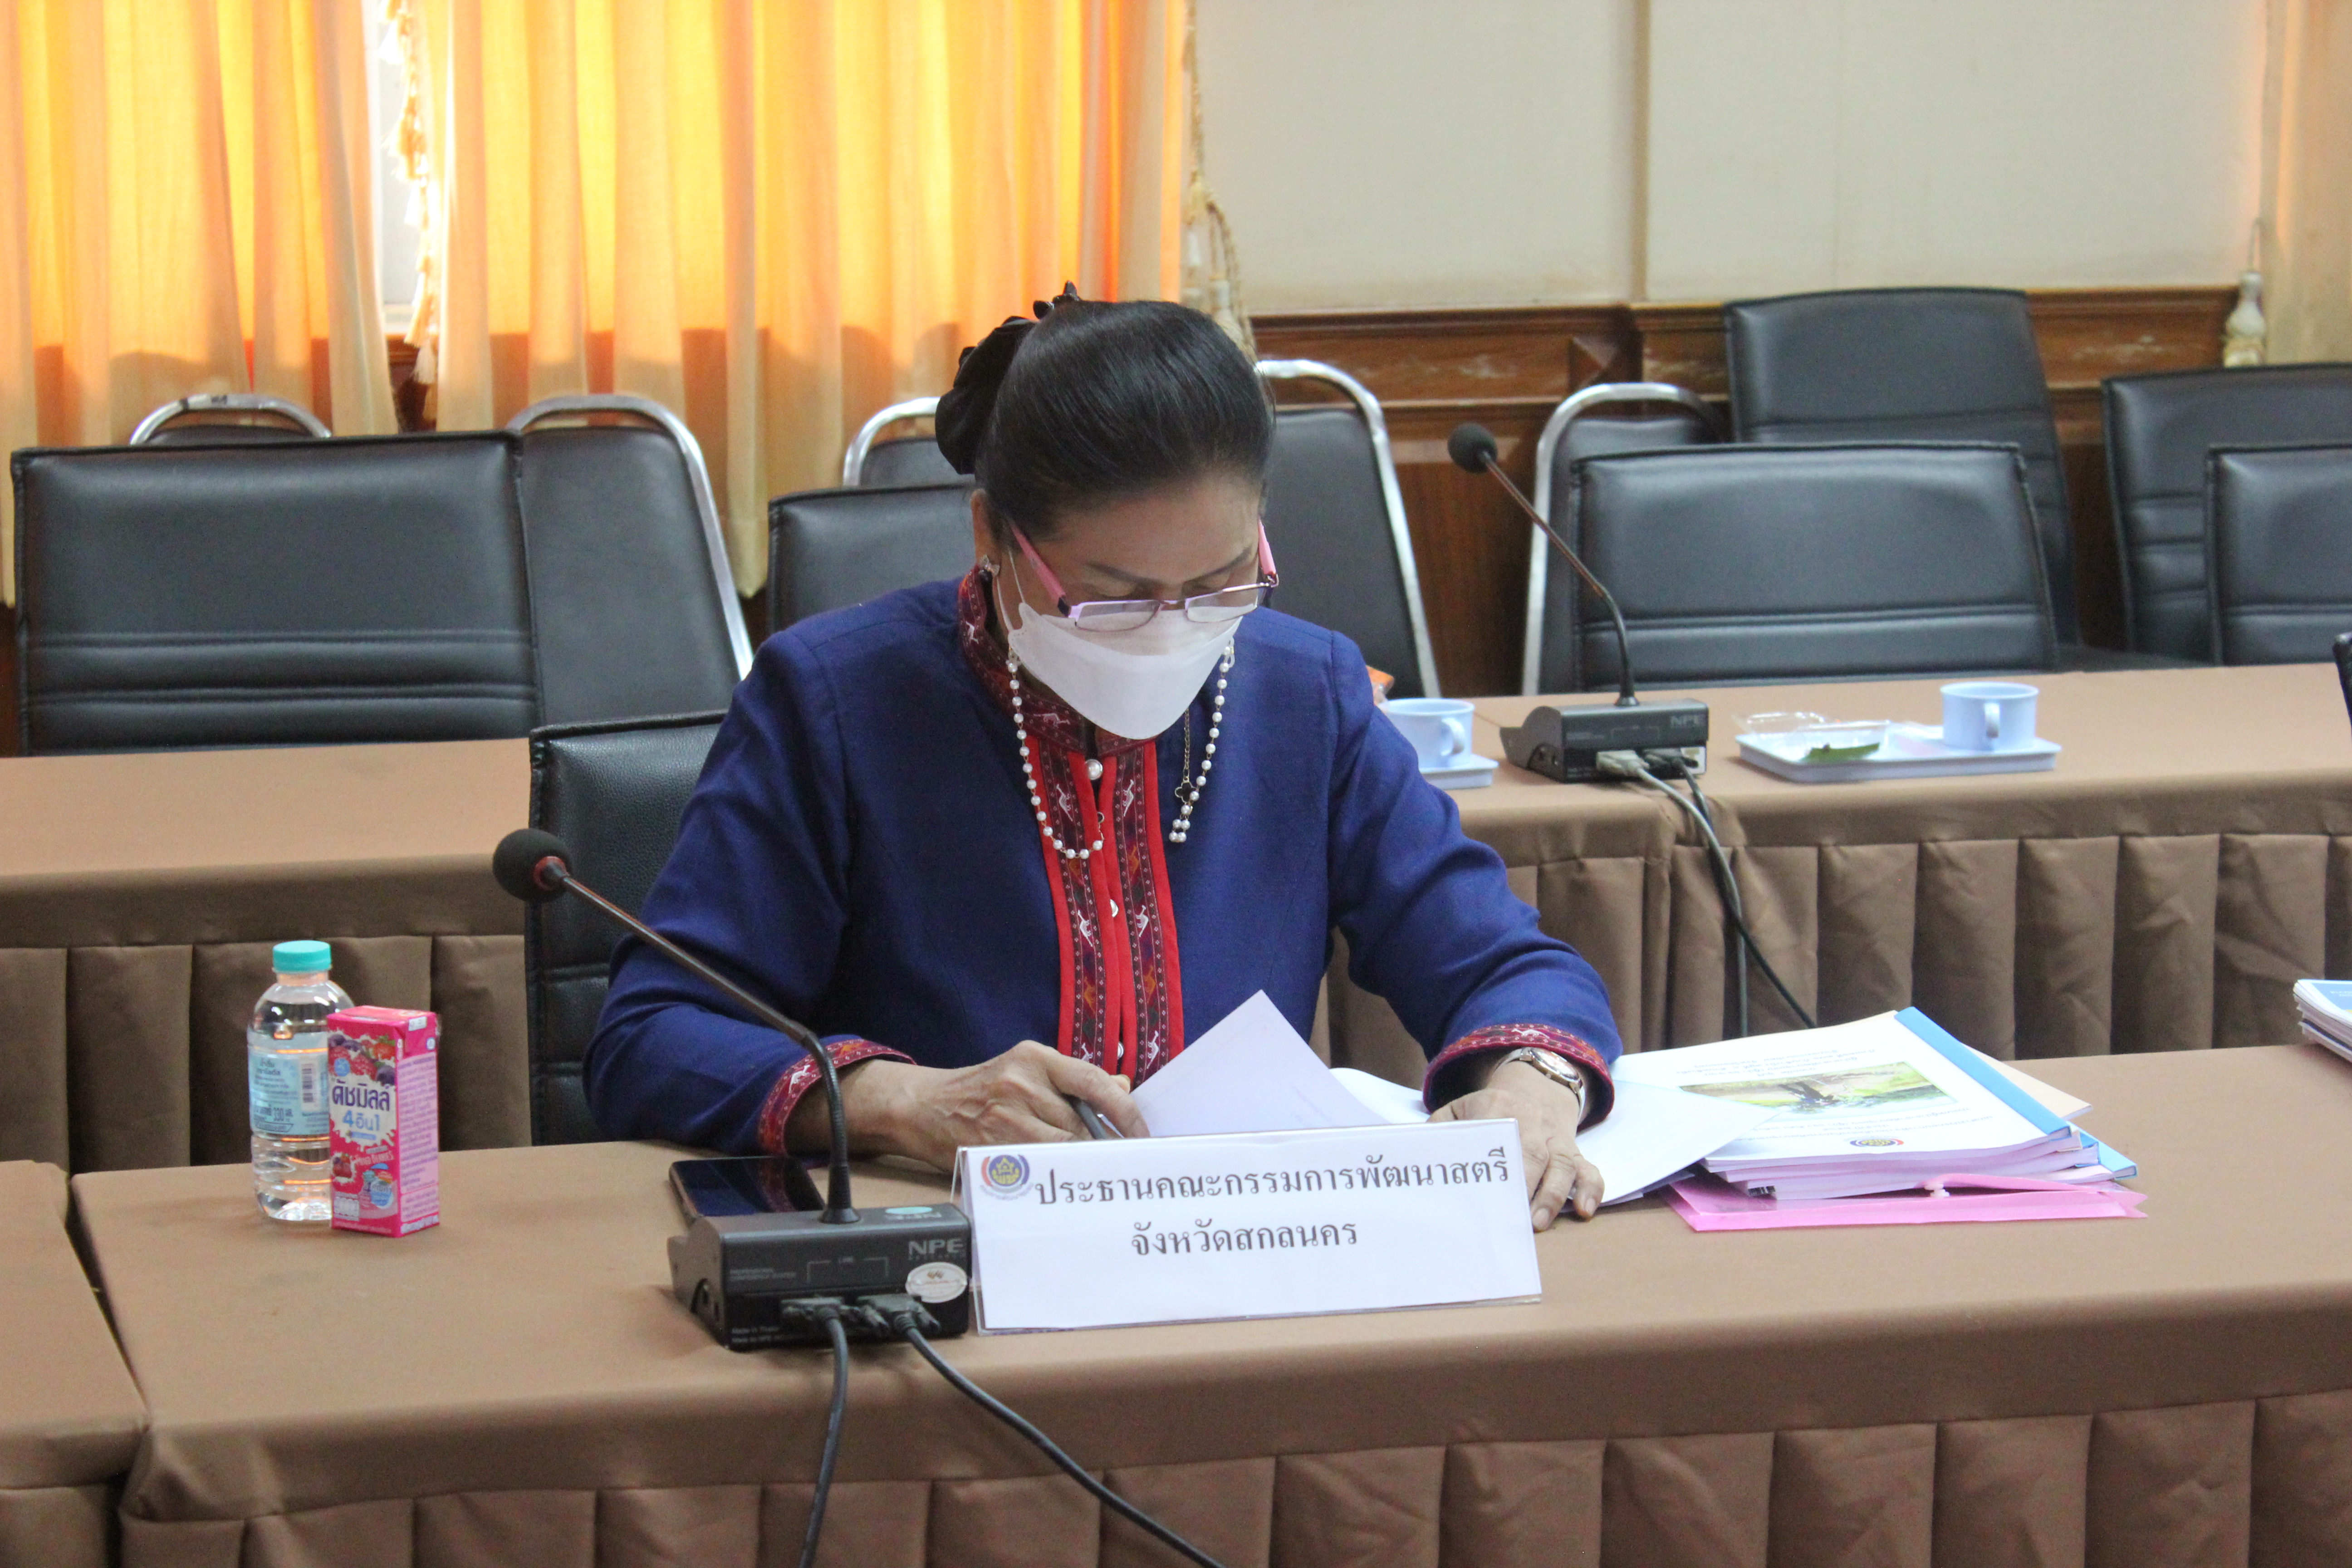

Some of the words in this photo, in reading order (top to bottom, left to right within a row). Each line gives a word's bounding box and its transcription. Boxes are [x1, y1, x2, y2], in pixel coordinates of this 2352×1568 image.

[332, 1078, 390, 1112] ดัชมิลล์
[1034, 1146, 1509, 1205] ประธานคณะกรรมการพัฒนาสตรี
[908, 1238, 964, 1255] NPE
[1131, 1218, 1358, 1256] จังหวัดสกลนคร
